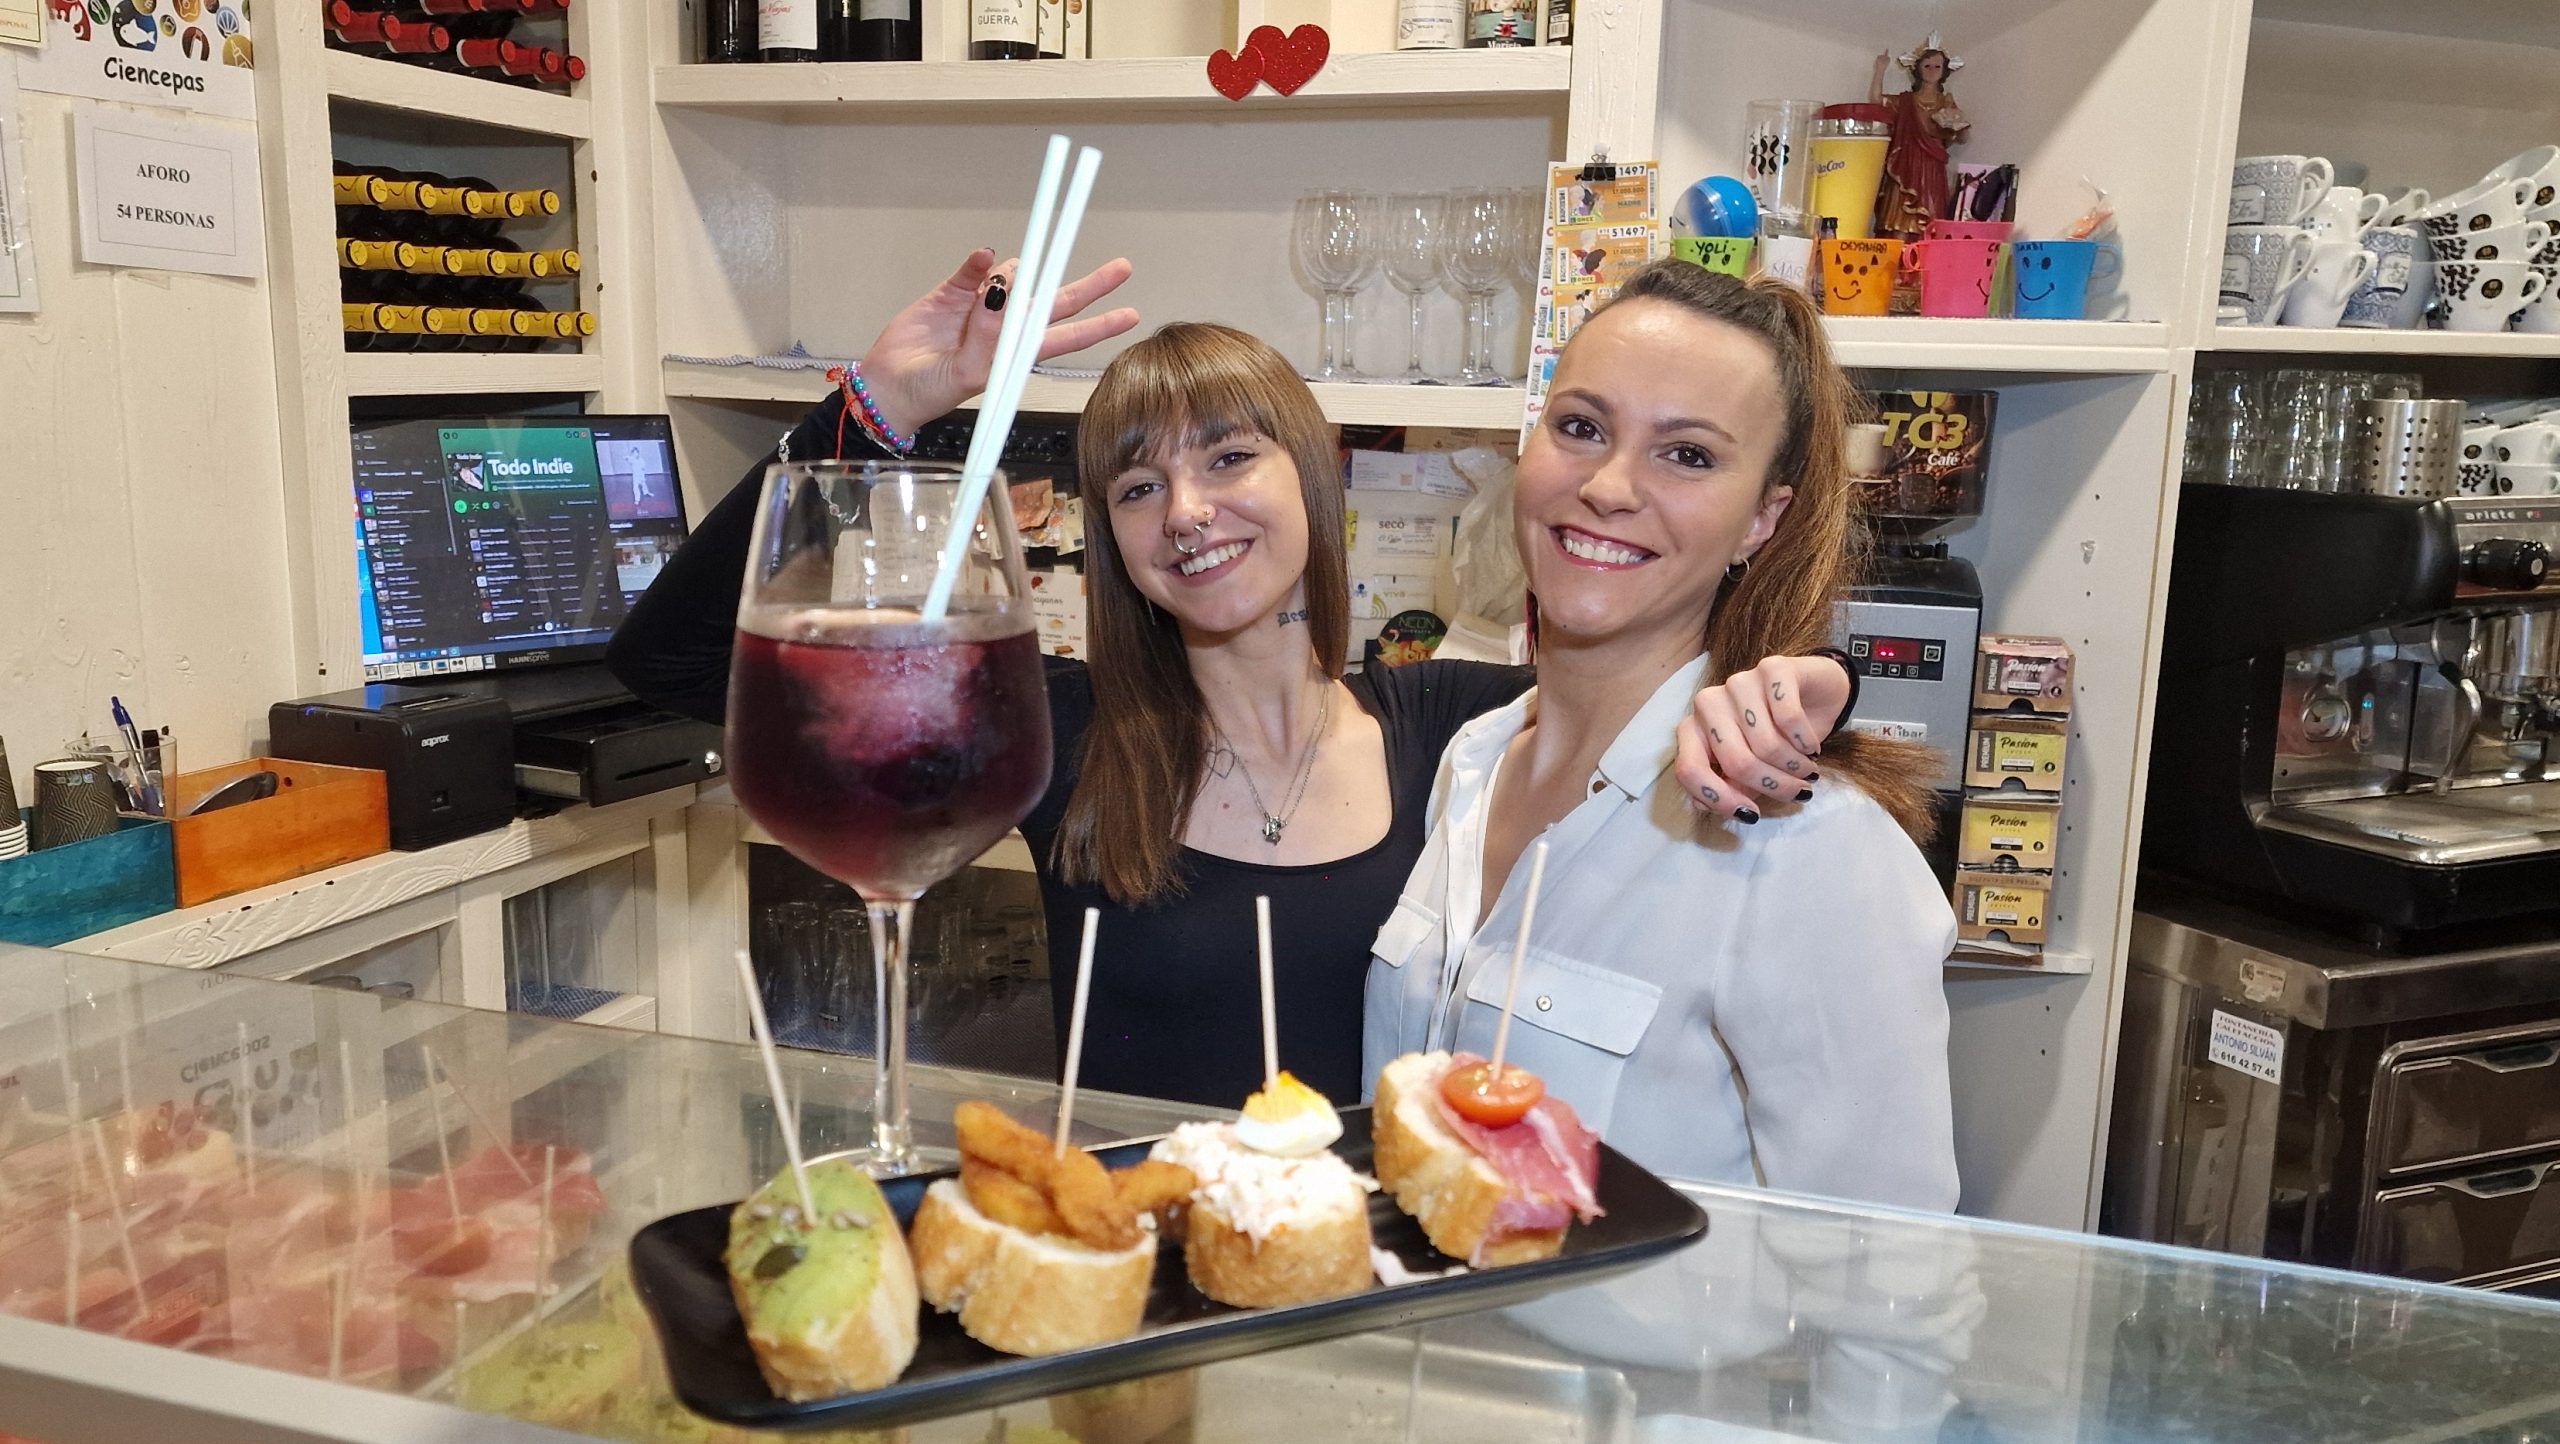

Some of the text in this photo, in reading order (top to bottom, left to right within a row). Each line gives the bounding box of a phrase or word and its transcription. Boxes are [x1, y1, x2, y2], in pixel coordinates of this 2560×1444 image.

[977, 15, 1019, 26] GUERRA
[104, 57, 205, 95] Ciencepas
[136, 163, 191, 184] AFORO
[1618, 165, 1645, 176] 1497
[117, 203, 215, 230] 54 PERSONAS
[1612, 226, 1646, 237] 51497
[1881, 411, 1968, 450] TC3
[487, 457, 574, 476] Todo Indie
[1927, 452, 1960, 466] Café
[1067, 503, 1076, 515] 5
[1987, 658, 1998, 691] PREMIUM
[1980, 736, 1991, 769] PREMIUM
[2214, 1033, 2248, 1053] ANTONIO
[2221, 1051, 2276, 1078] 616 42 57 45
